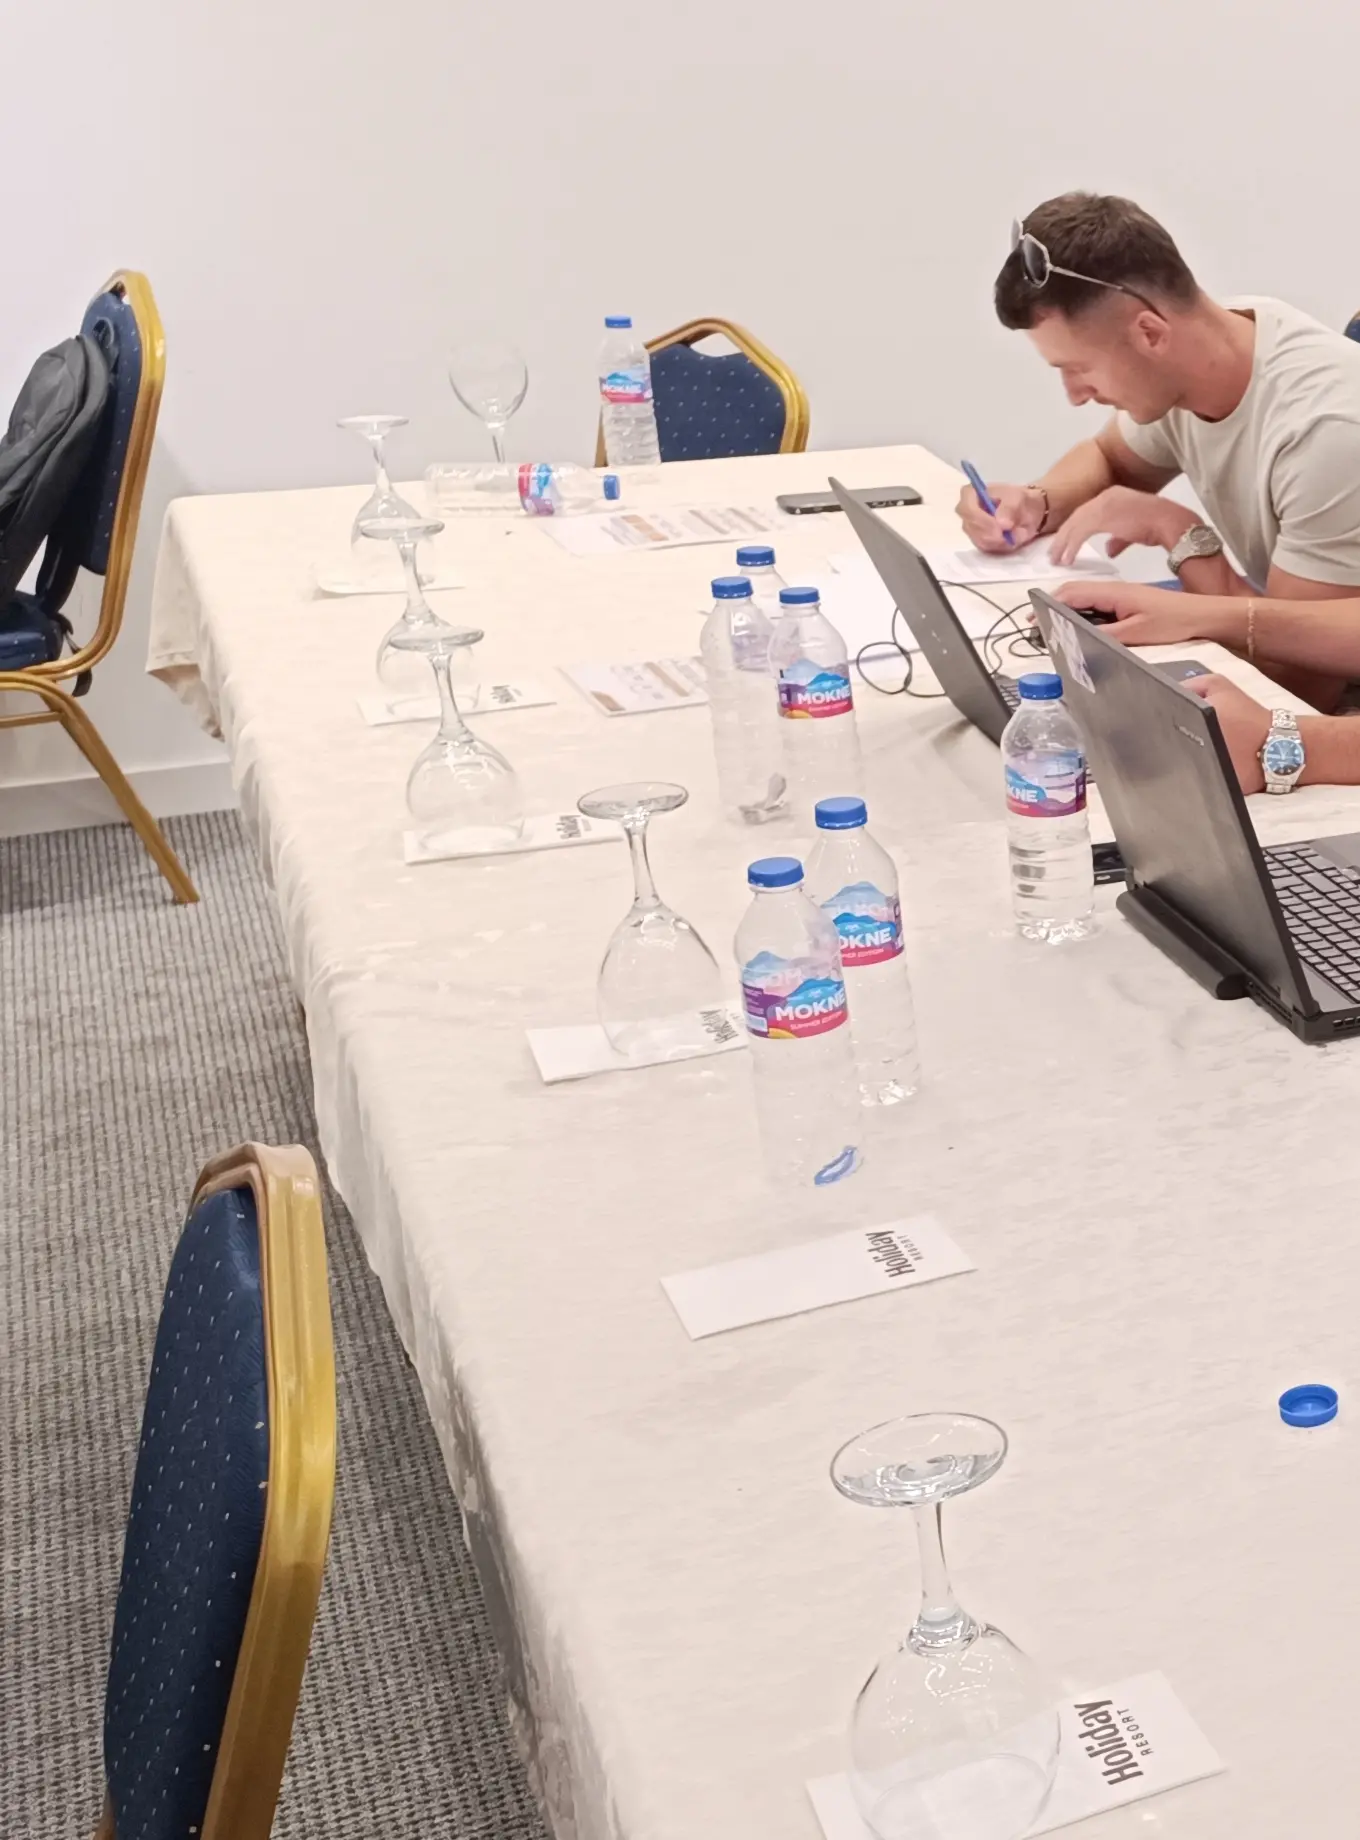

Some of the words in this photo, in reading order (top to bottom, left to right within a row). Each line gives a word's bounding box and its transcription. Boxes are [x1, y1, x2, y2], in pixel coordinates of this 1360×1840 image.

[797, 685, 851, 705] MOKNE
[1007, 783, 1038, 803] KNE
[840, 927, 891, 950] OKNE
[775, 988, 846, 1021] MOKNE
[865, 1230, 916, 1278] Holiday
[1073, 1699, 1144, 1785] Holiday
[1116, 1708, 1154, 1757] RESORT
